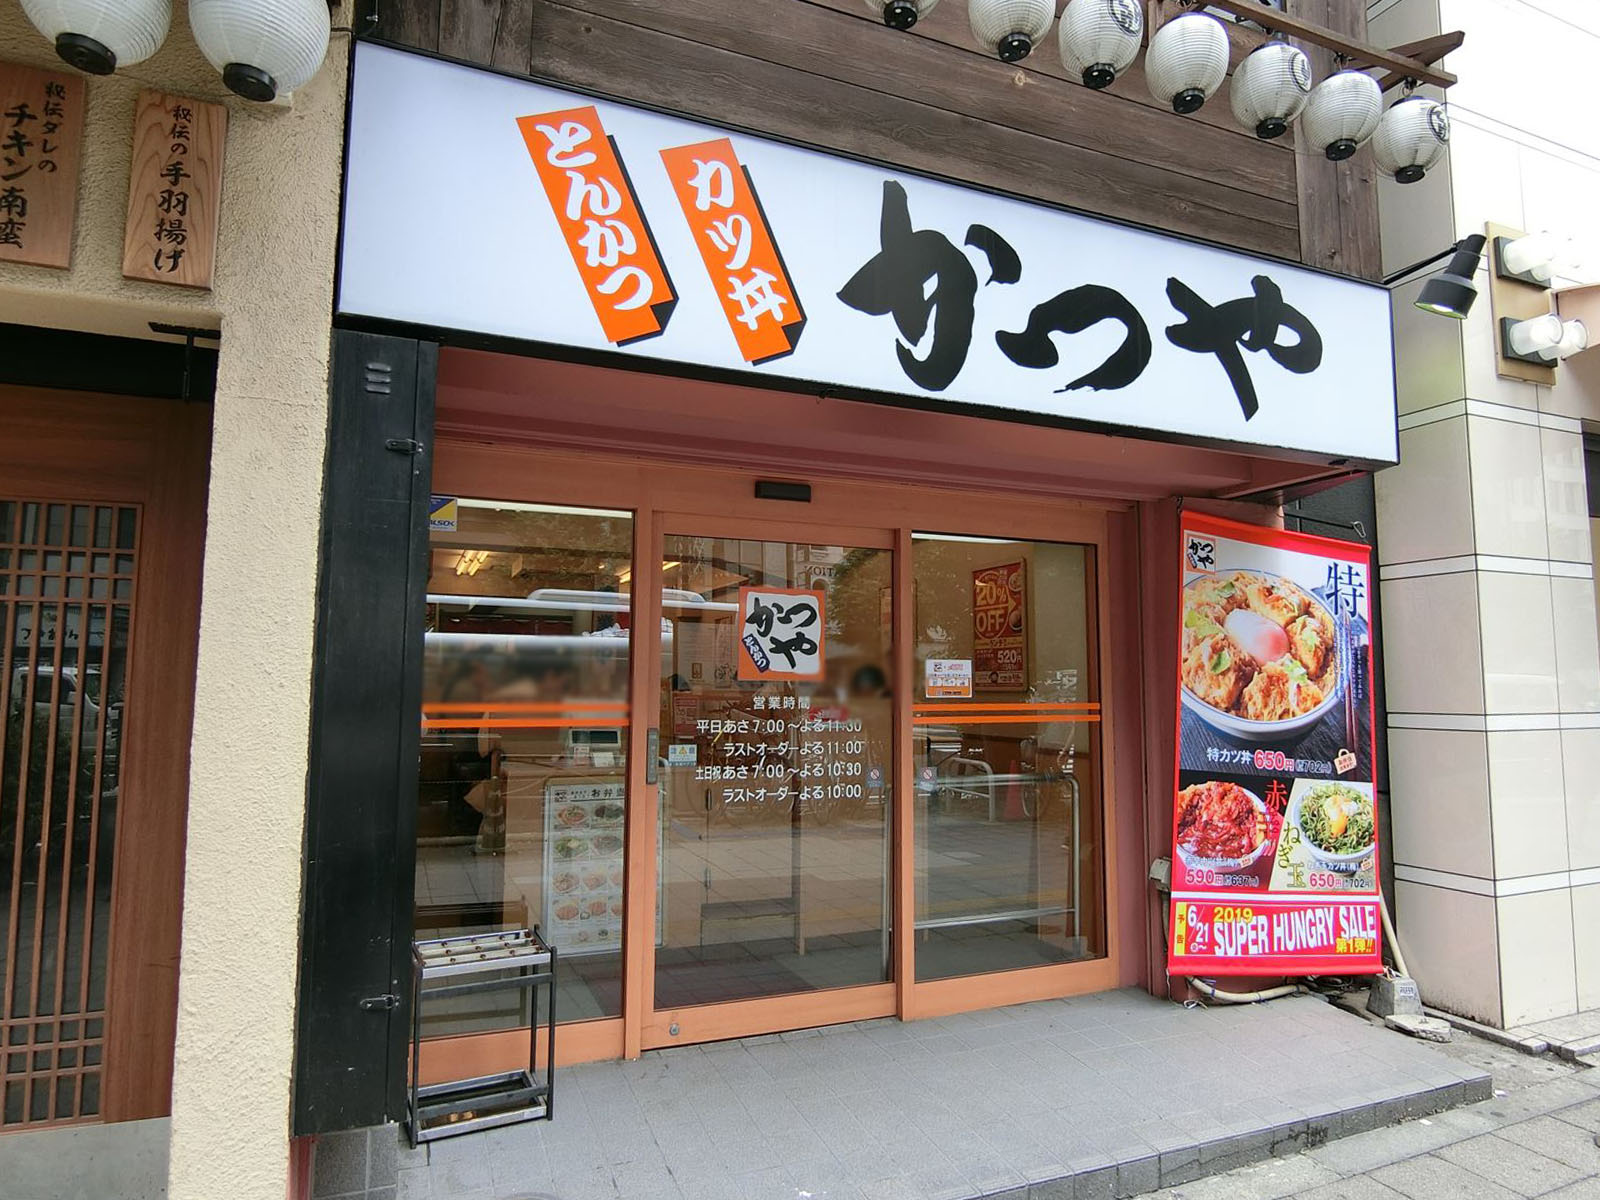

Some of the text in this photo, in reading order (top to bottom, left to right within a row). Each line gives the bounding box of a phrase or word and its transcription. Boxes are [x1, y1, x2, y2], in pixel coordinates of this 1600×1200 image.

[39, 81, 66, 174] 秘伝タレの
[0, 103, 38, 250] チキン南蛮
[153, 104, 193, 273] 秘伝の手羽揚げ
[535, 121, 654, 311] とんかつ
[687, 159, 788, 331] カツ丼
[837, 180, 1322, 421] かつや
[976, 609, 1004, 632] OFF
[1326, 562, 1364, 618] 特
[753, 695, 810, 710] 営業時間
[1207, 747, 1251, 764] 特カツ丼
[1213, 906, 1253, 924] 2019
[1213, 904, 1376, 957] SUPER HUNGRY SALE
